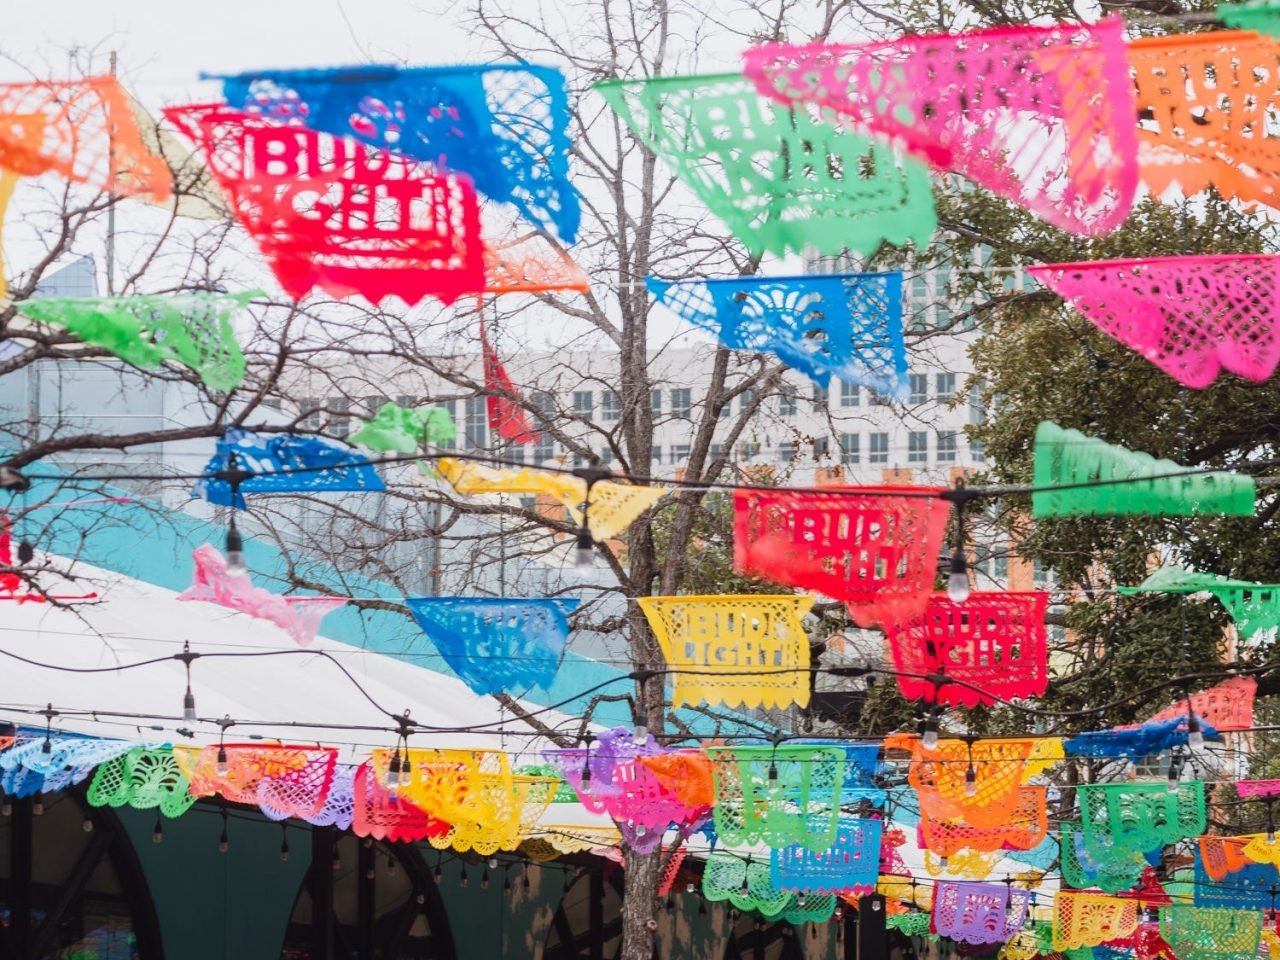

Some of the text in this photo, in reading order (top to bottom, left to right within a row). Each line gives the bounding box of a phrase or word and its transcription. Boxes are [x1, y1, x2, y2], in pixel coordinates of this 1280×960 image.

[793, 512, 893, 547] BUD
[689, 612, 768, 638] BUD
[927, 609, 1002, 638] BUD
[678, 640, 787, 668] LIGHT
